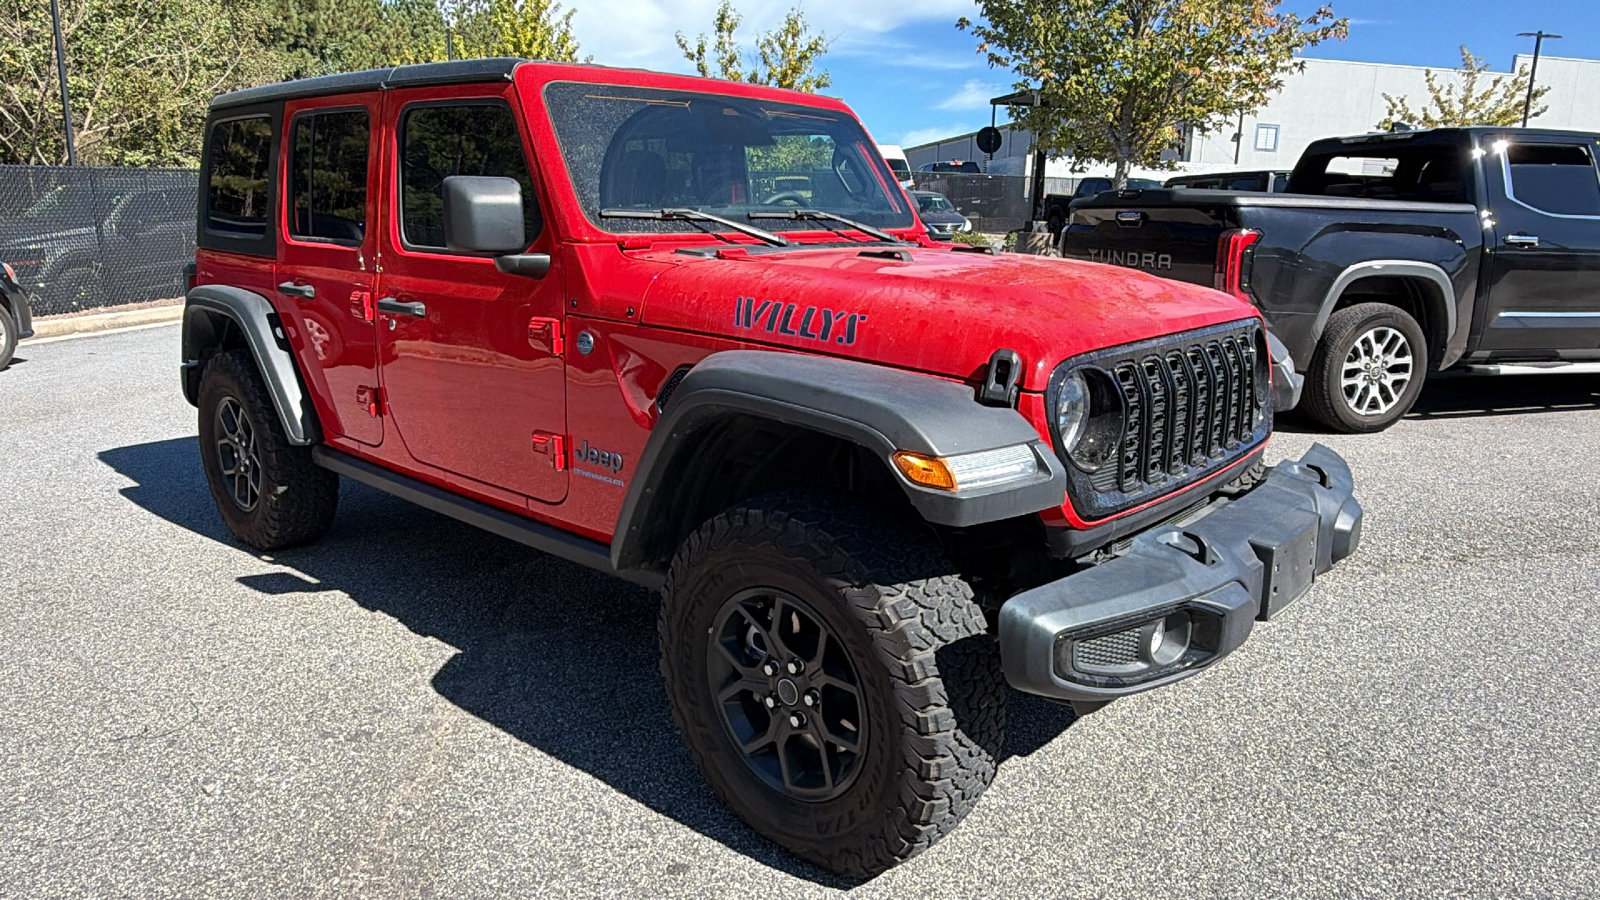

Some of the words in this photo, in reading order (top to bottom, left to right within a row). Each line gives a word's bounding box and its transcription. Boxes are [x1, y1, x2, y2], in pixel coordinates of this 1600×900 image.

[1088, 248, 1172, 269] TUNDRA
[734, 296, 868, 346] WILLYS
[575, 439, 624, 475] Jeep
